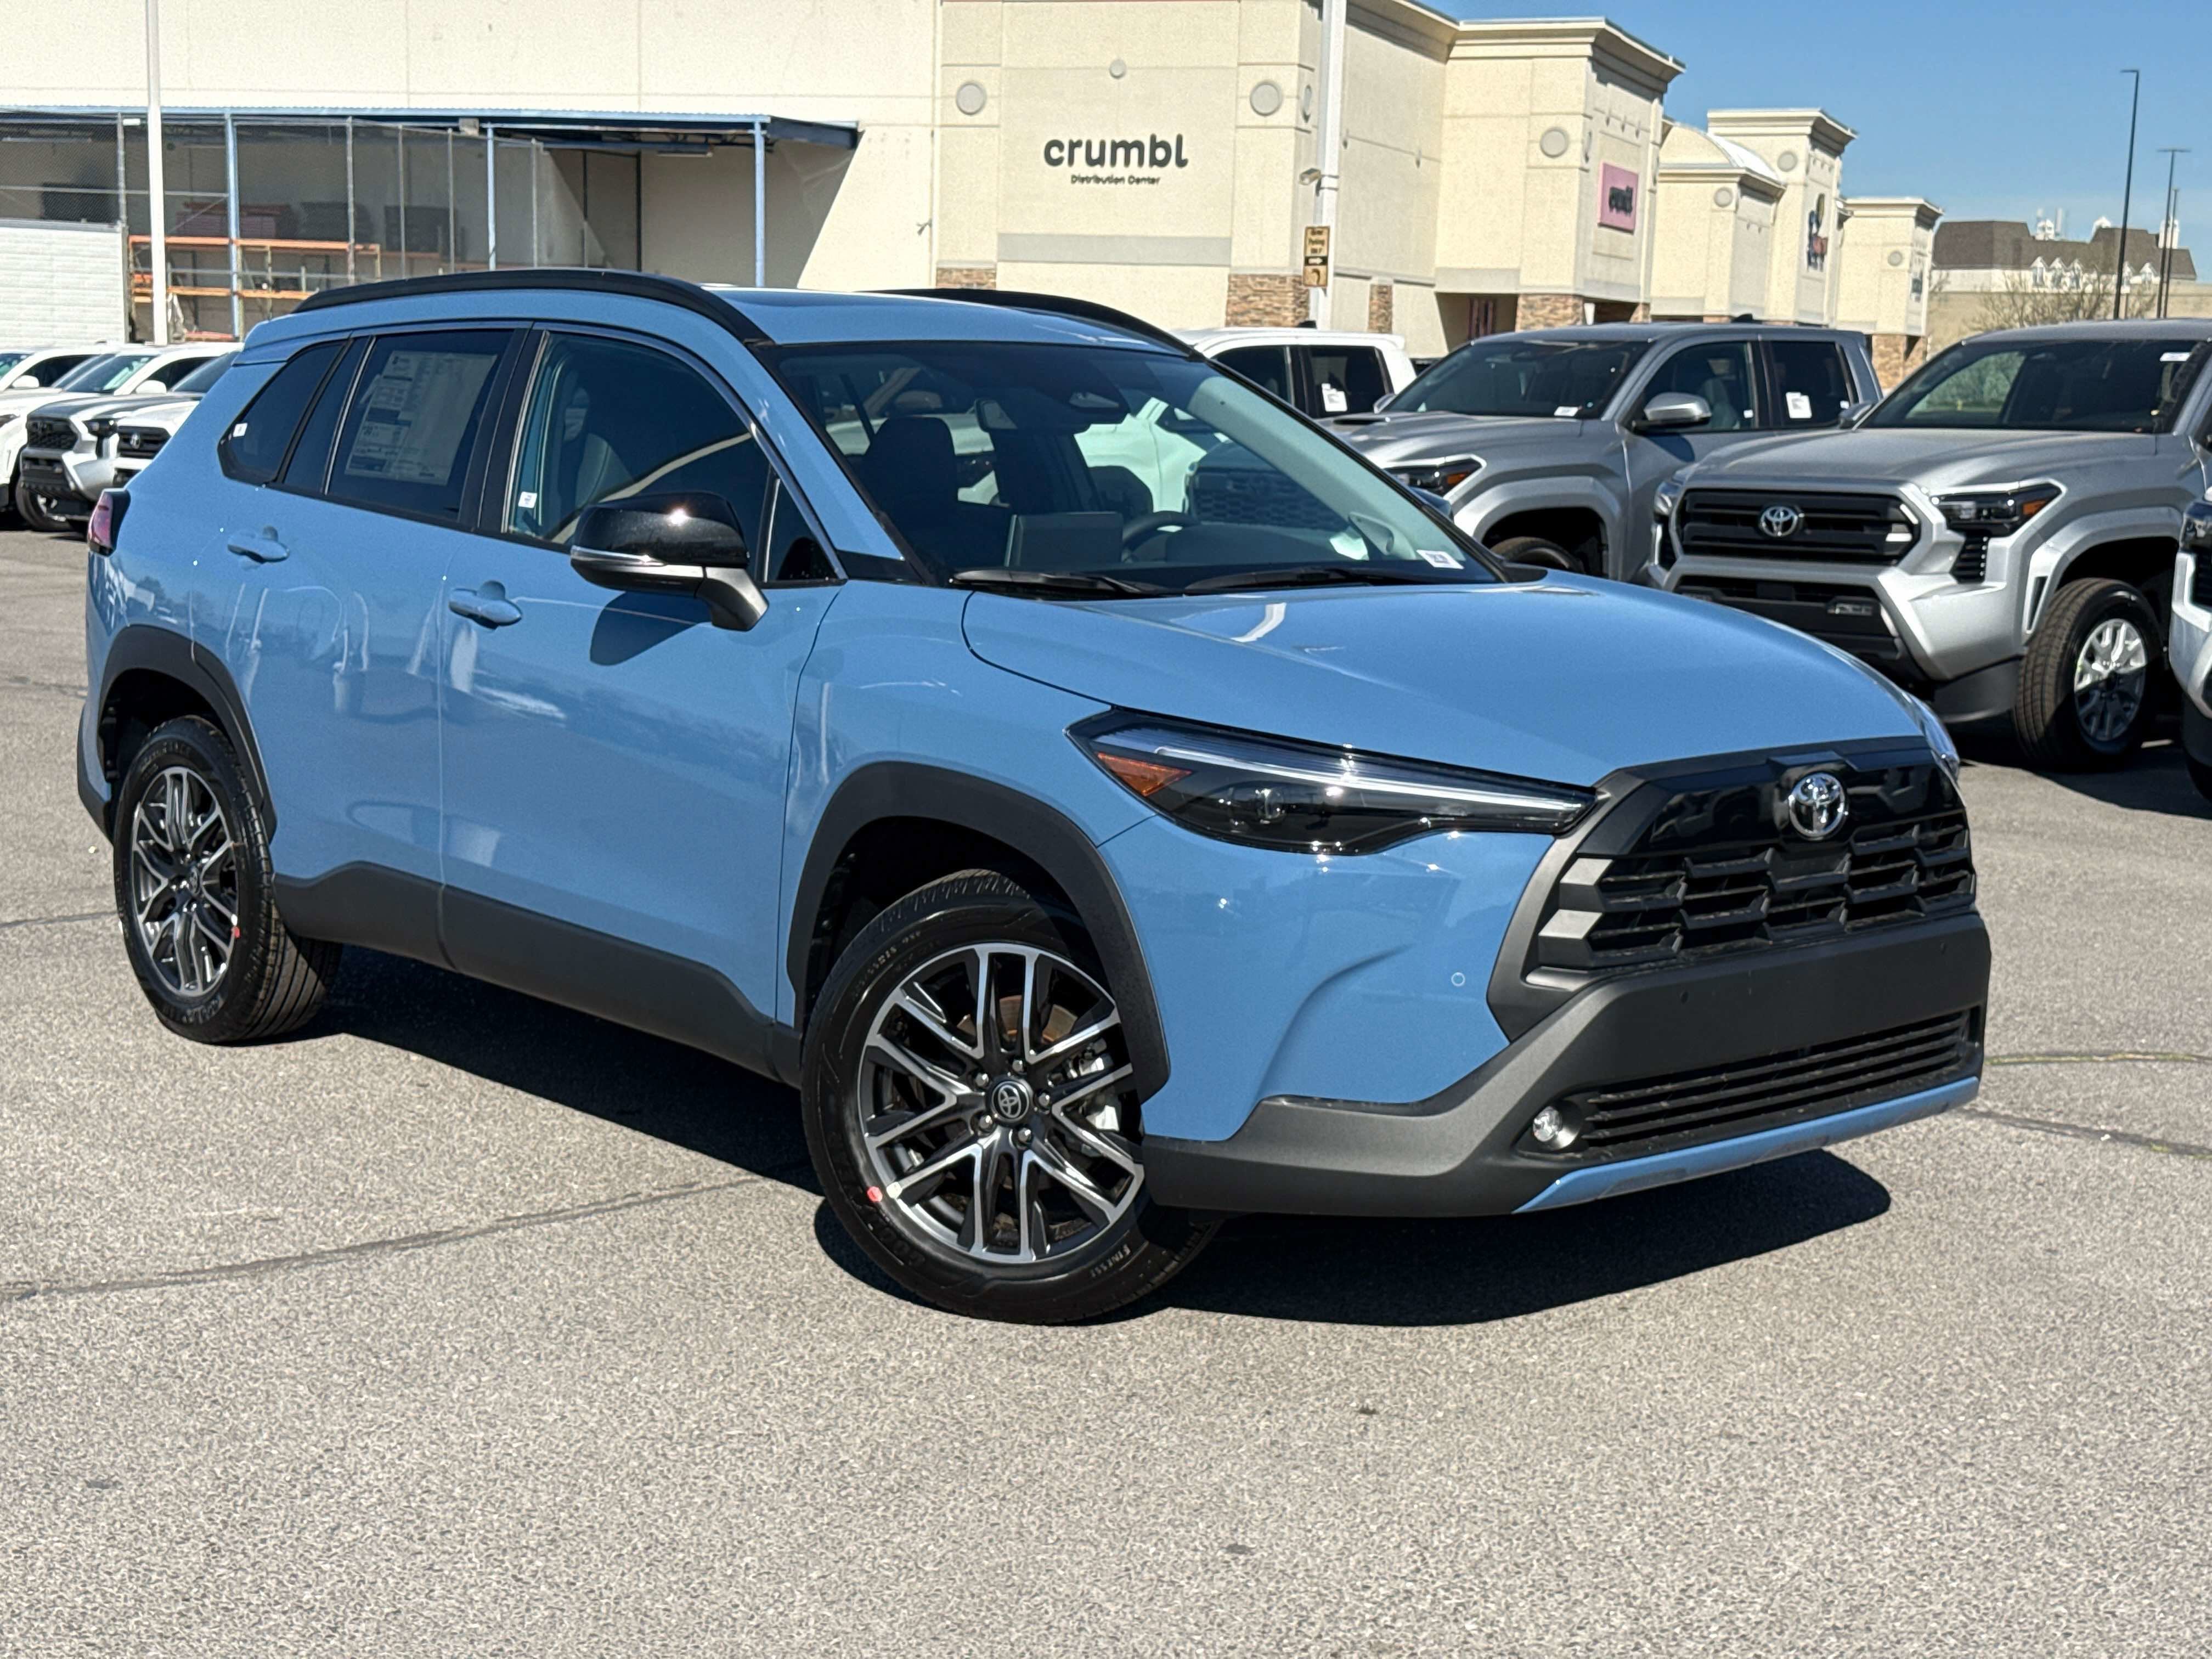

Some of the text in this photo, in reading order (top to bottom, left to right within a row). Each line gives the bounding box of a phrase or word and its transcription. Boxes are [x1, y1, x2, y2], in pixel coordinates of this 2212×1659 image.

[1043, 133, 1188, 168] crumbl
[1071, 174, 1160, 184] Distribution Center
